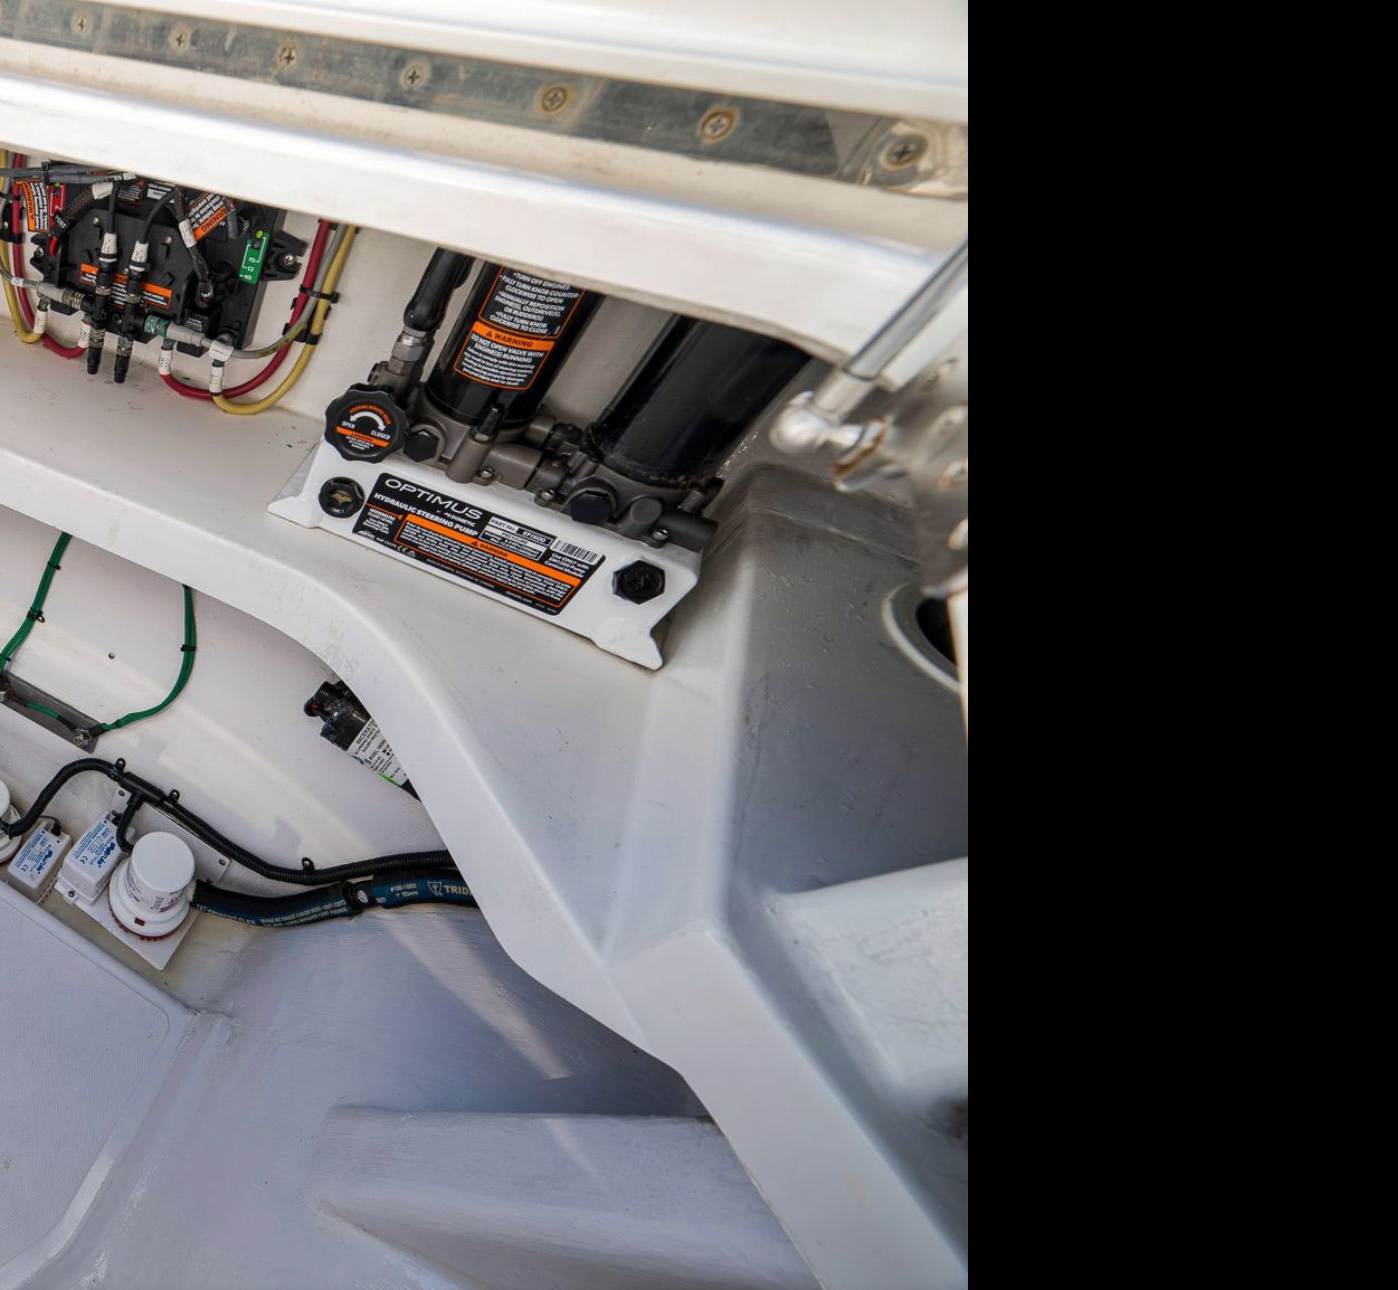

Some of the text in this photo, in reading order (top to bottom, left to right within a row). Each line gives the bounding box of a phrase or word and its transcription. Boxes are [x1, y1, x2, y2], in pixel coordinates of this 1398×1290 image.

[494, 333, 533, 348] WARNING
[342, 420, 391, 440] OPEN CLOSED
[385, 478, 483, 520] OPTIMUS
[373, 492, 479, 537] HYDRAULIC STEERING PUMP
[443, 884, 471, 896] TRID
